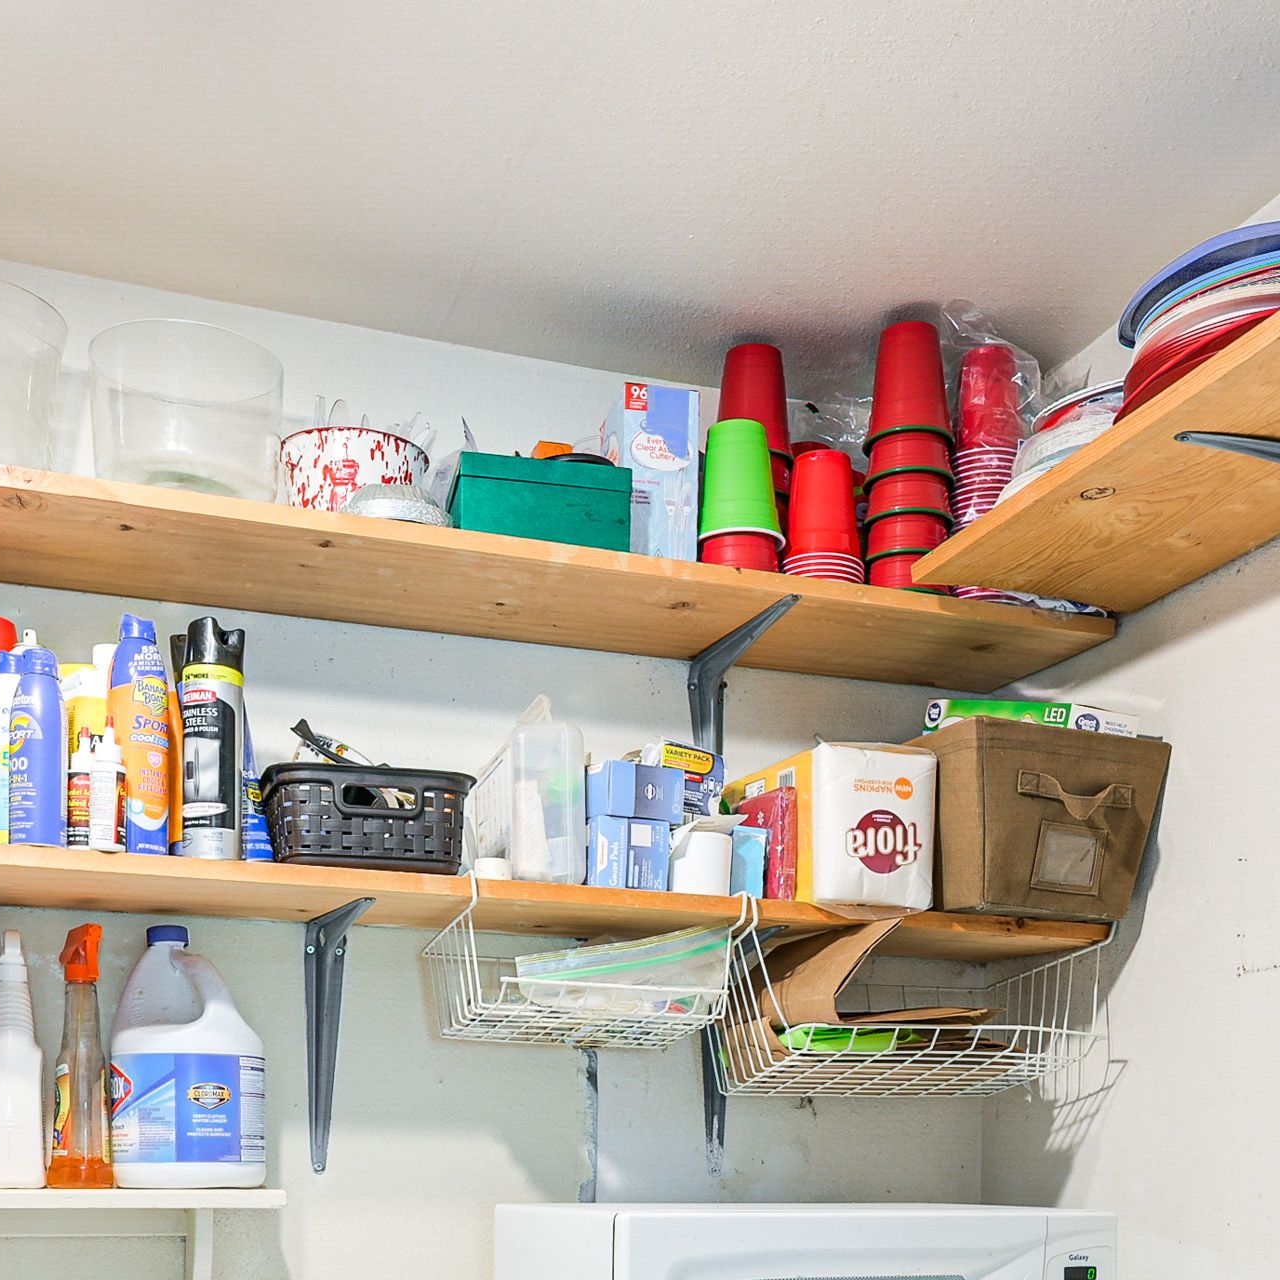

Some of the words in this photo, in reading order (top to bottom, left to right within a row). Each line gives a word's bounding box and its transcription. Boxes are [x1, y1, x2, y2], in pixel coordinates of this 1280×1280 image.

[631, 386, 648, 400] 96
[143, 692, 165, 706] BOAT
[185, 716, 208, 727] STEEL
[1043, 707, 1067, 723] LED
[665, 748, 691, 760] VARIETY
[693, 752, 711, 764] PACK
[853, 783, 893, 793] NAPKINS
[1068, 1253, 1090, 1262] Galaxy
